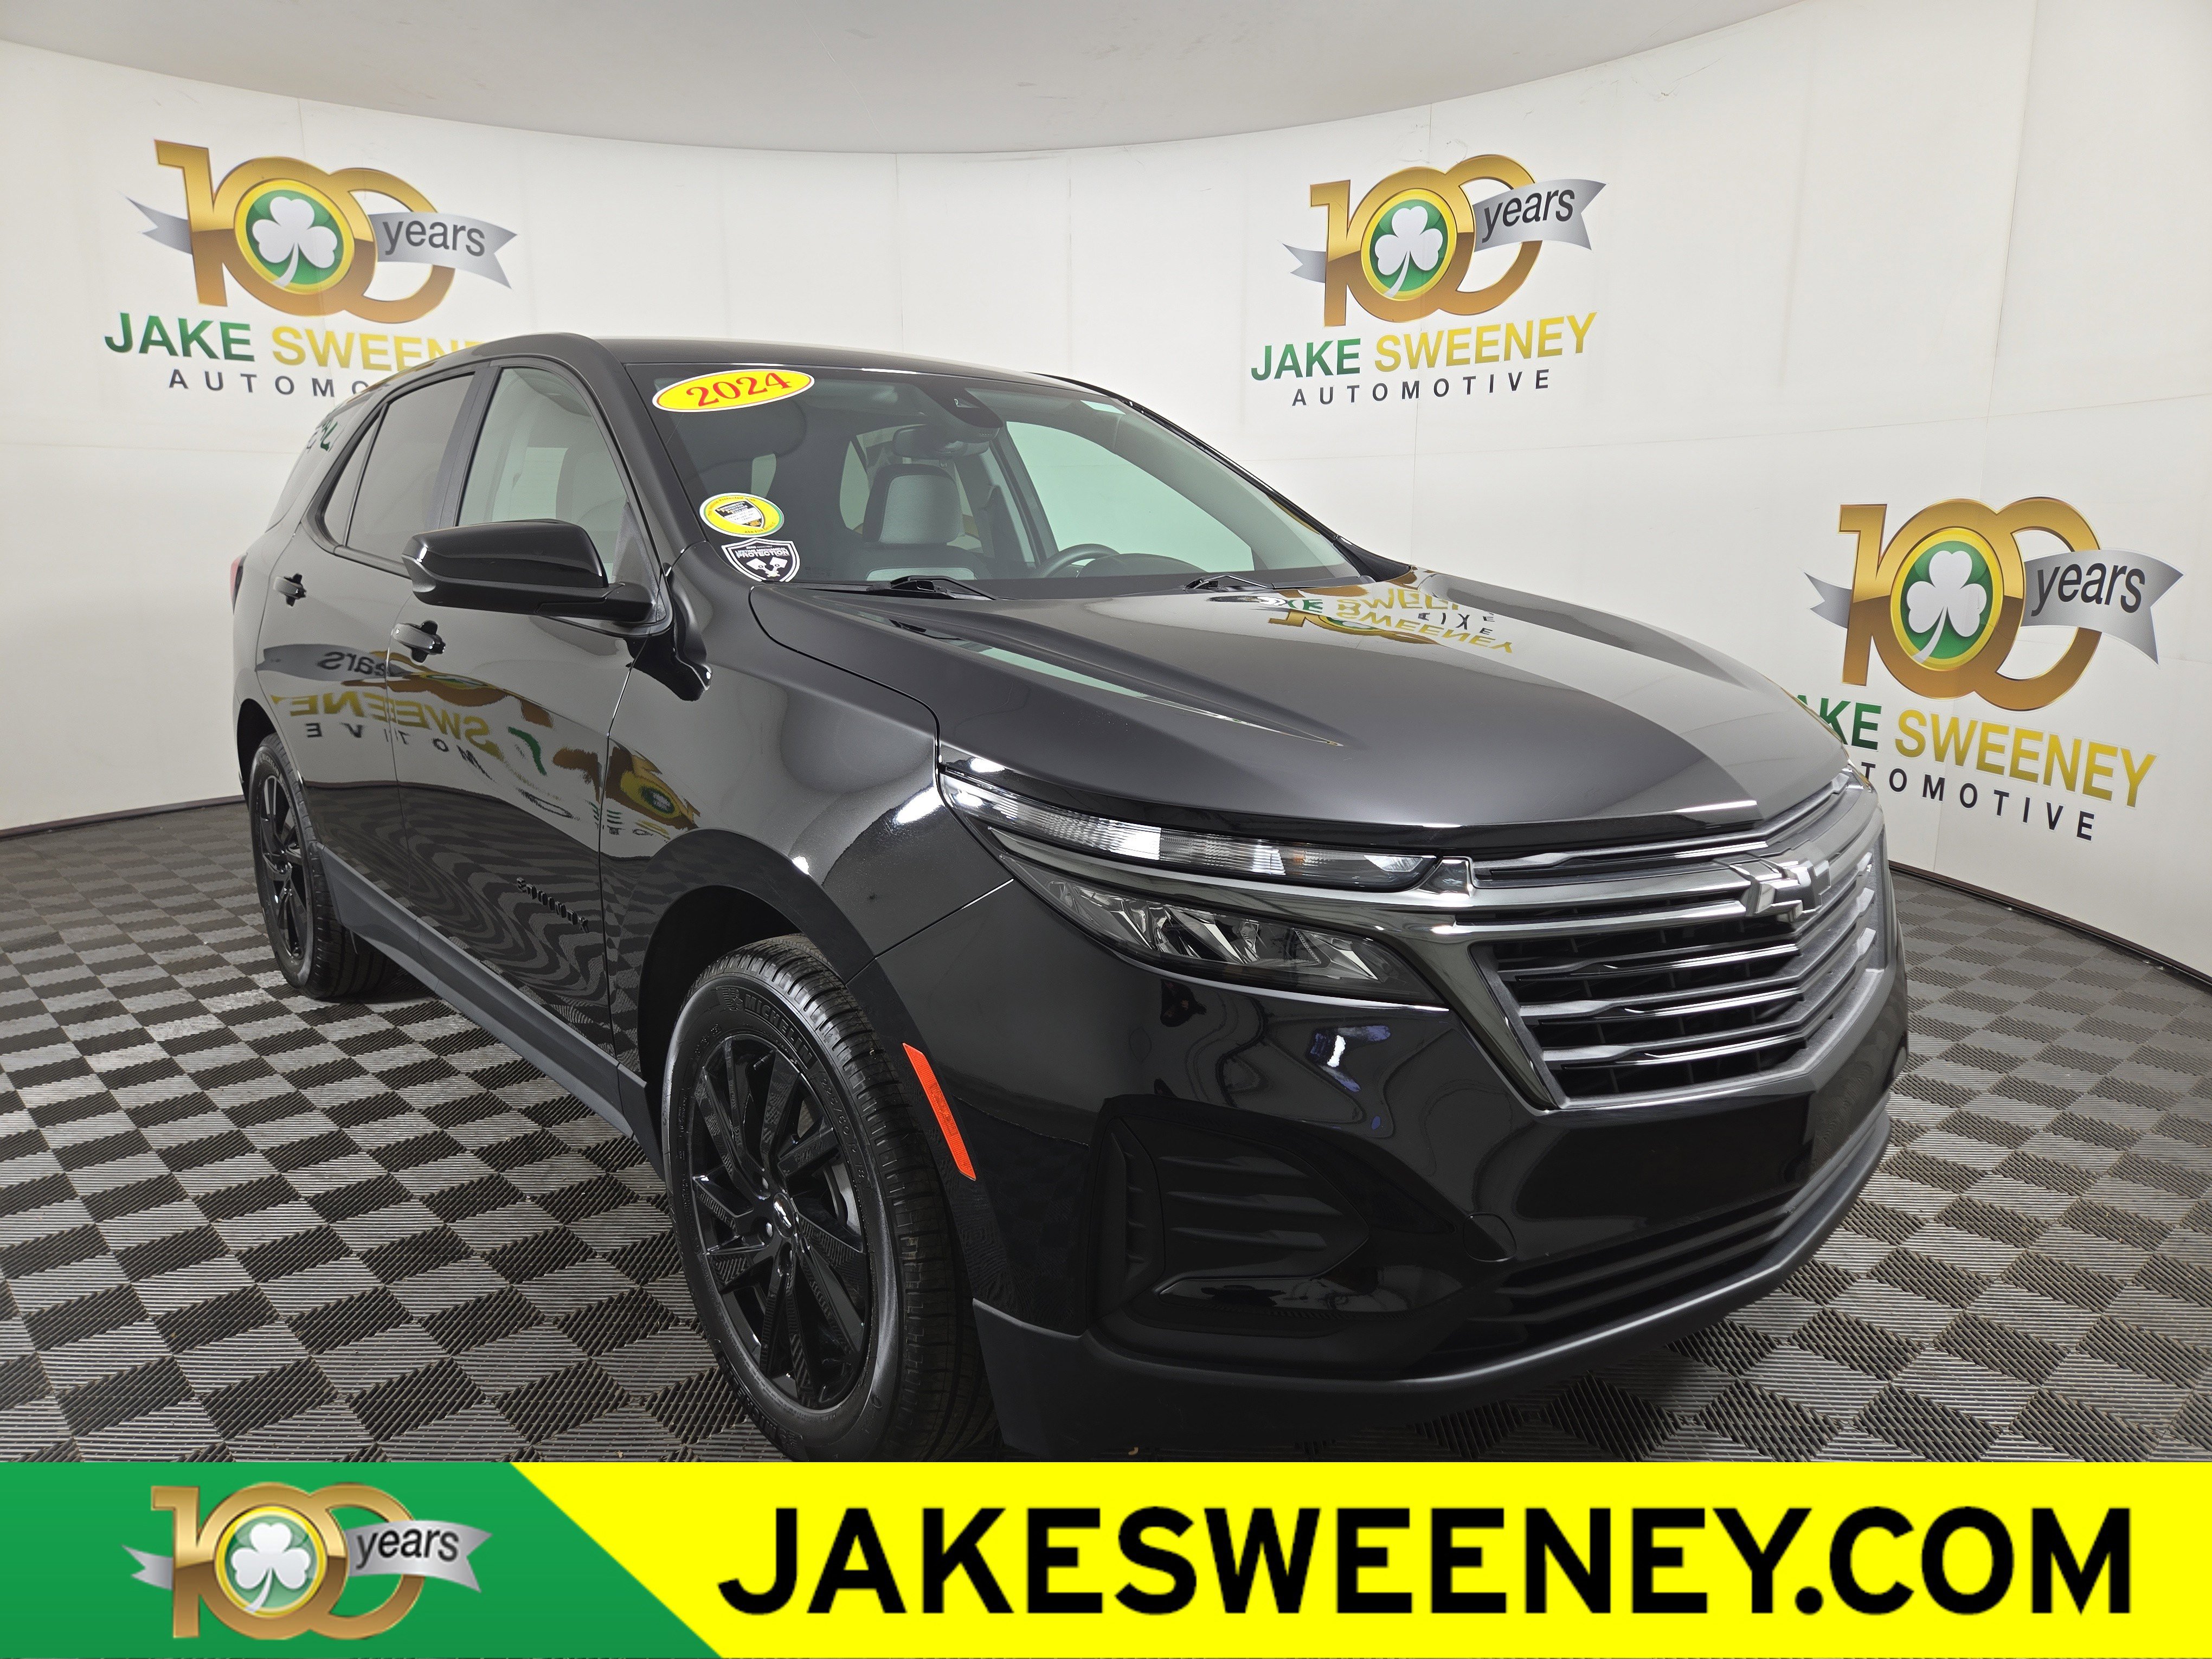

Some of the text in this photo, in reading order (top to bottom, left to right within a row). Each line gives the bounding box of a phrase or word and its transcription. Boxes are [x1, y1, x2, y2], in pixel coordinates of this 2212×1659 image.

[153, 139, 455, 324] 100
[382, 220, 486, 257] years
[1309, 154, 1543, 327] 100
[1482, 189, 1576, 244] years
[104, 312, 487, 371] JAKE SWEEN
[1251, 312, 1597, 381] JAKE SWEENEY
[686, 372, 792, 407] 2024
[1292, 369, 1549, 406] AUTOMOTIVE
[1837, 496, 2101, 711] 100
[2031, 562, 2146, 617] years
[1797, 695, 2157, 808] KE SWEENEY
[1861, 761, 2095, 841] TOMOTIVE
[745, 994, 814, 1064] MICHELIN
